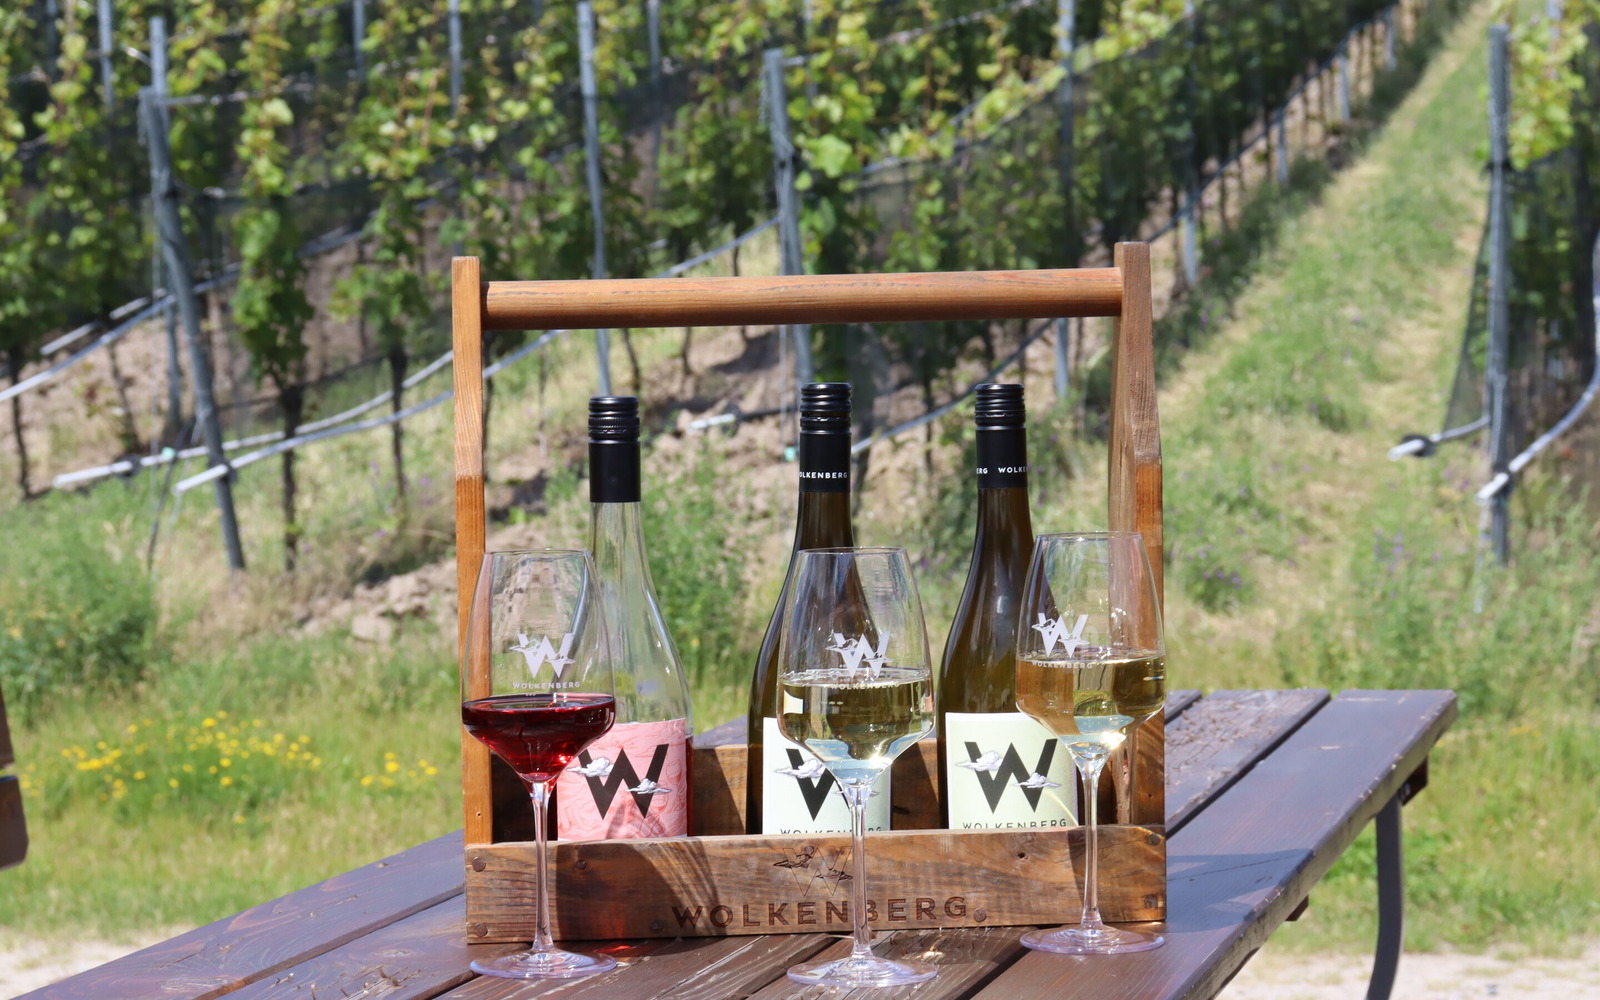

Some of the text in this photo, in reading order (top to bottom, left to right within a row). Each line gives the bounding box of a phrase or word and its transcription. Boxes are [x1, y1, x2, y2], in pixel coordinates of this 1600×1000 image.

[517, 632, 575, 679] W
[833, 631, 891, 680] W
[1038, 612, 1089, 659] W
[512, 681, 580, 690] WOLKENBERG
[577, 743, 670, 821] W
[964, 738, 1058, 815] W
[671, 896, 967, 930] WOLKENBERG
